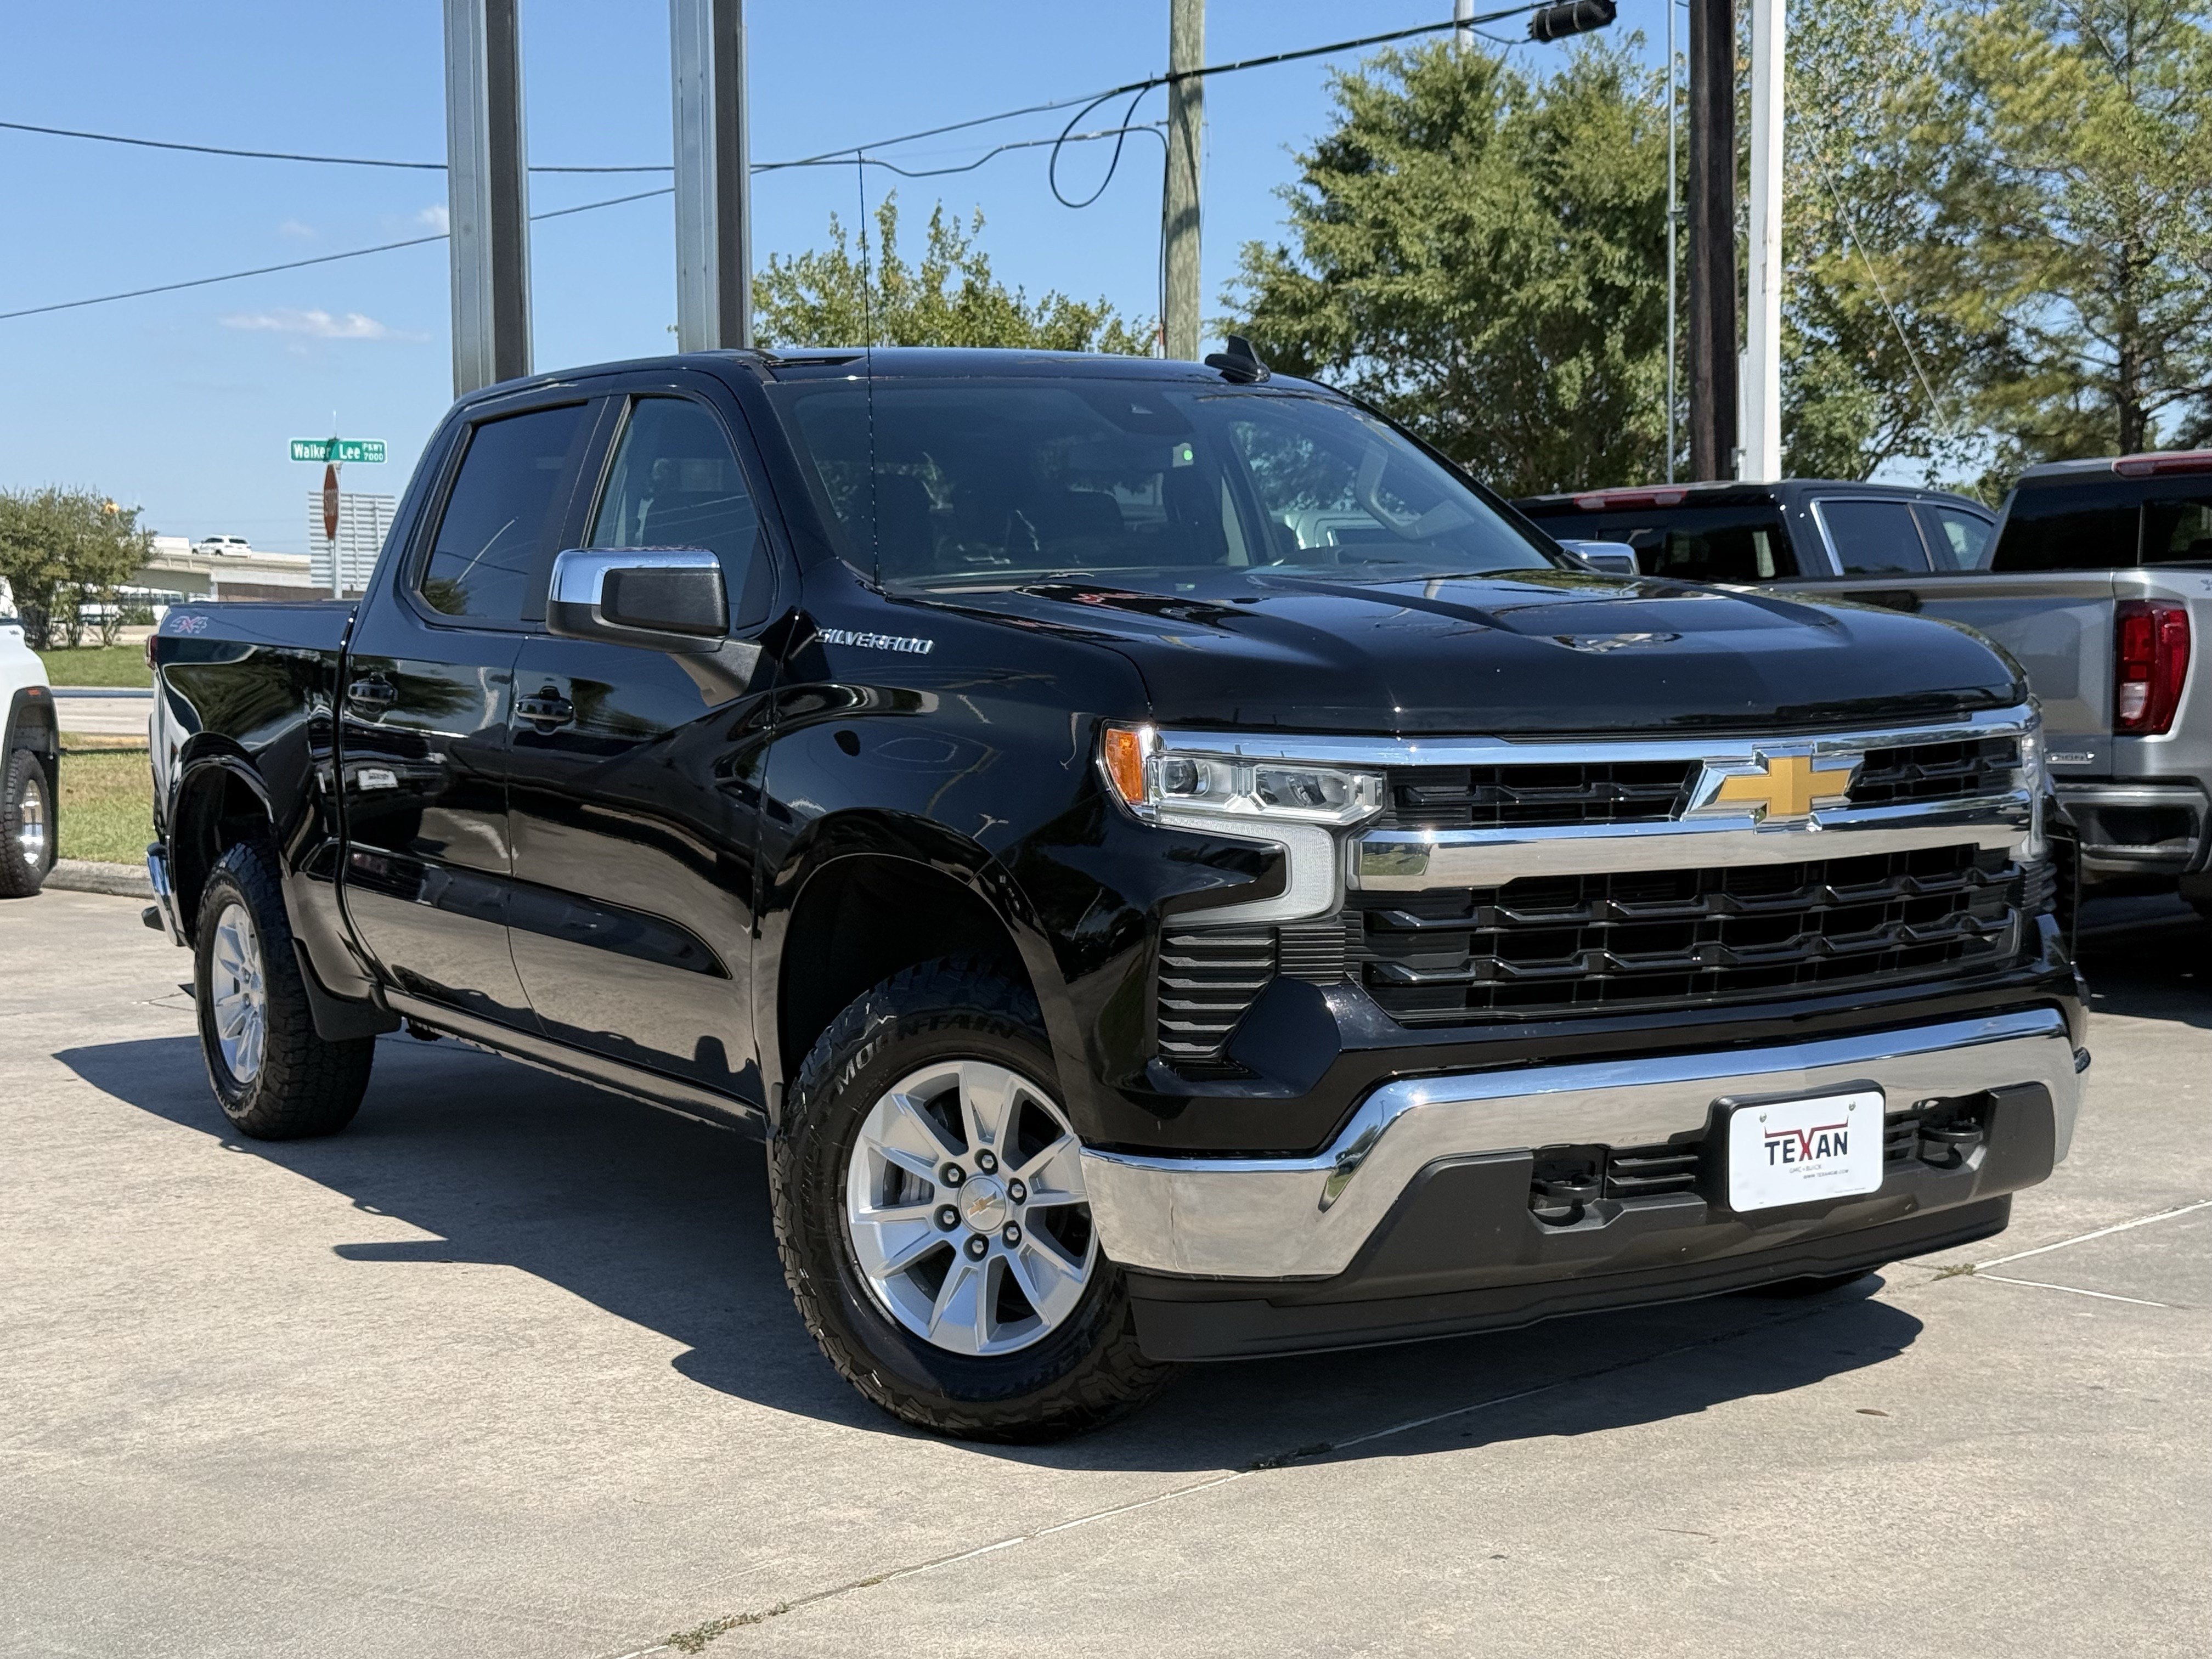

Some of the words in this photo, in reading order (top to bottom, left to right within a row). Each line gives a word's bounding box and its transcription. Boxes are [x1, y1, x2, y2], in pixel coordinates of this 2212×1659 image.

[294, 443, 331, 459] Walker
[339, 444, 360, 459] Lee
[363, 443, 383, 452] PKWY
[364, 452, 383, 461] 7000
[815, 629, 933, 655] SILVERADO
[1764, 1124, 1848, 1166] TEXAN
